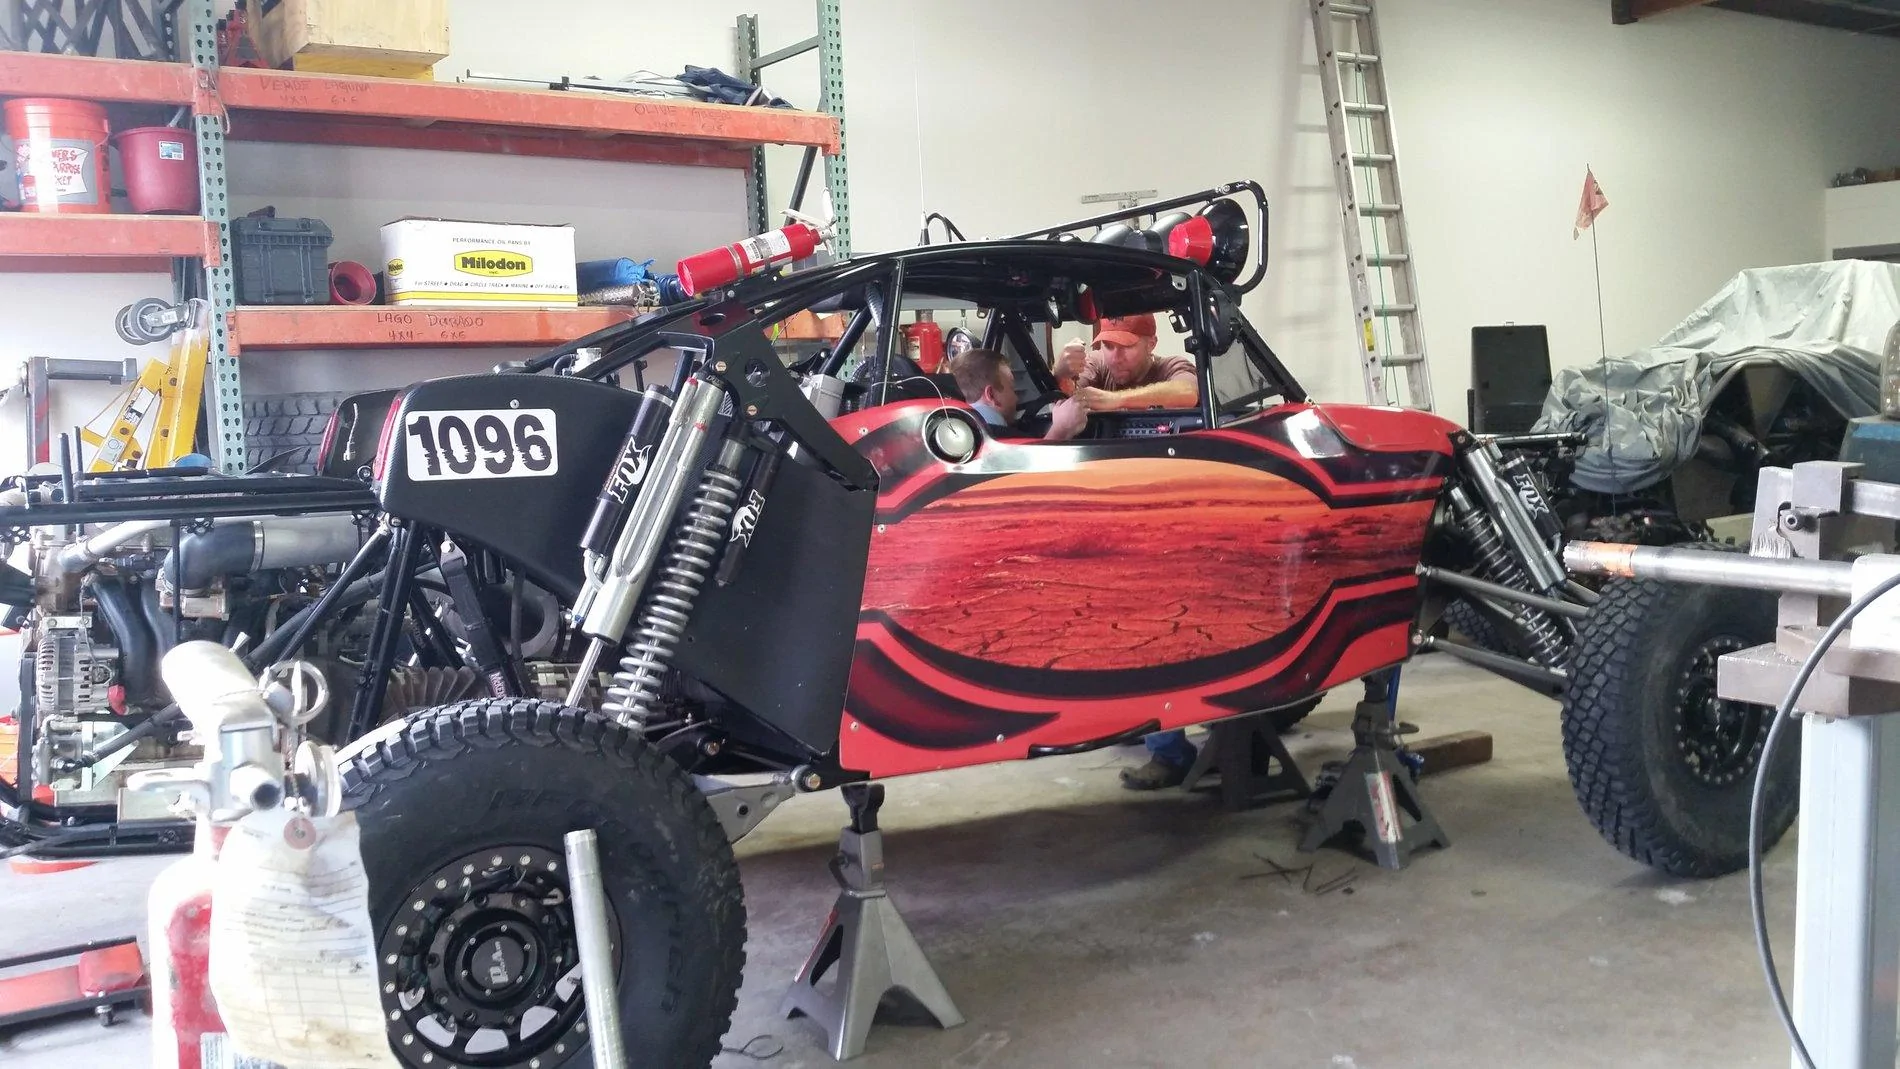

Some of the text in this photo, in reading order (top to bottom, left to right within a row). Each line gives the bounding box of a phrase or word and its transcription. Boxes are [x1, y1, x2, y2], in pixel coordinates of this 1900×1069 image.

[634, 102, 677, 116] OLIVE
[452, 237, 495, 245] PERFORMANCE
[461, 256, 526, 271] Milodon
[377, 312, 413, 325] LAGO
[407, 413, 553, 476] 1096
[607, 437, 651, 504] FOX
[1512, 473, 1550, 518] FOX
[729, 489, 766, 548] FOX
